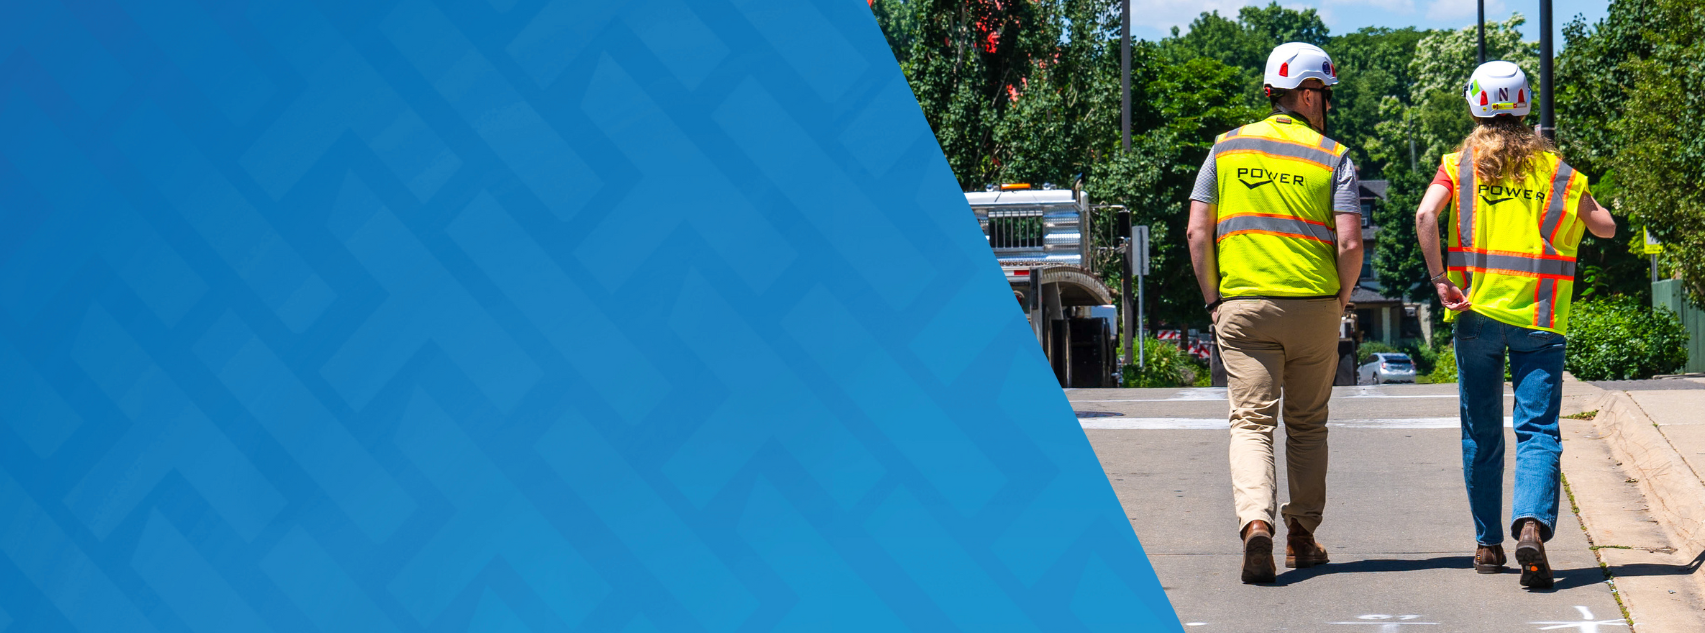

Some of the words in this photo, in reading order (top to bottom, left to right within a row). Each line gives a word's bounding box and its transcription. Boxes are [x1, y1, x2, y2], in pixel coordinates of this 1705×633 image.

[1499, 87, 1508, 101] N
[1237, 168, 1304, 186] POWER
[1478, 184, 1545, 203] POWER
